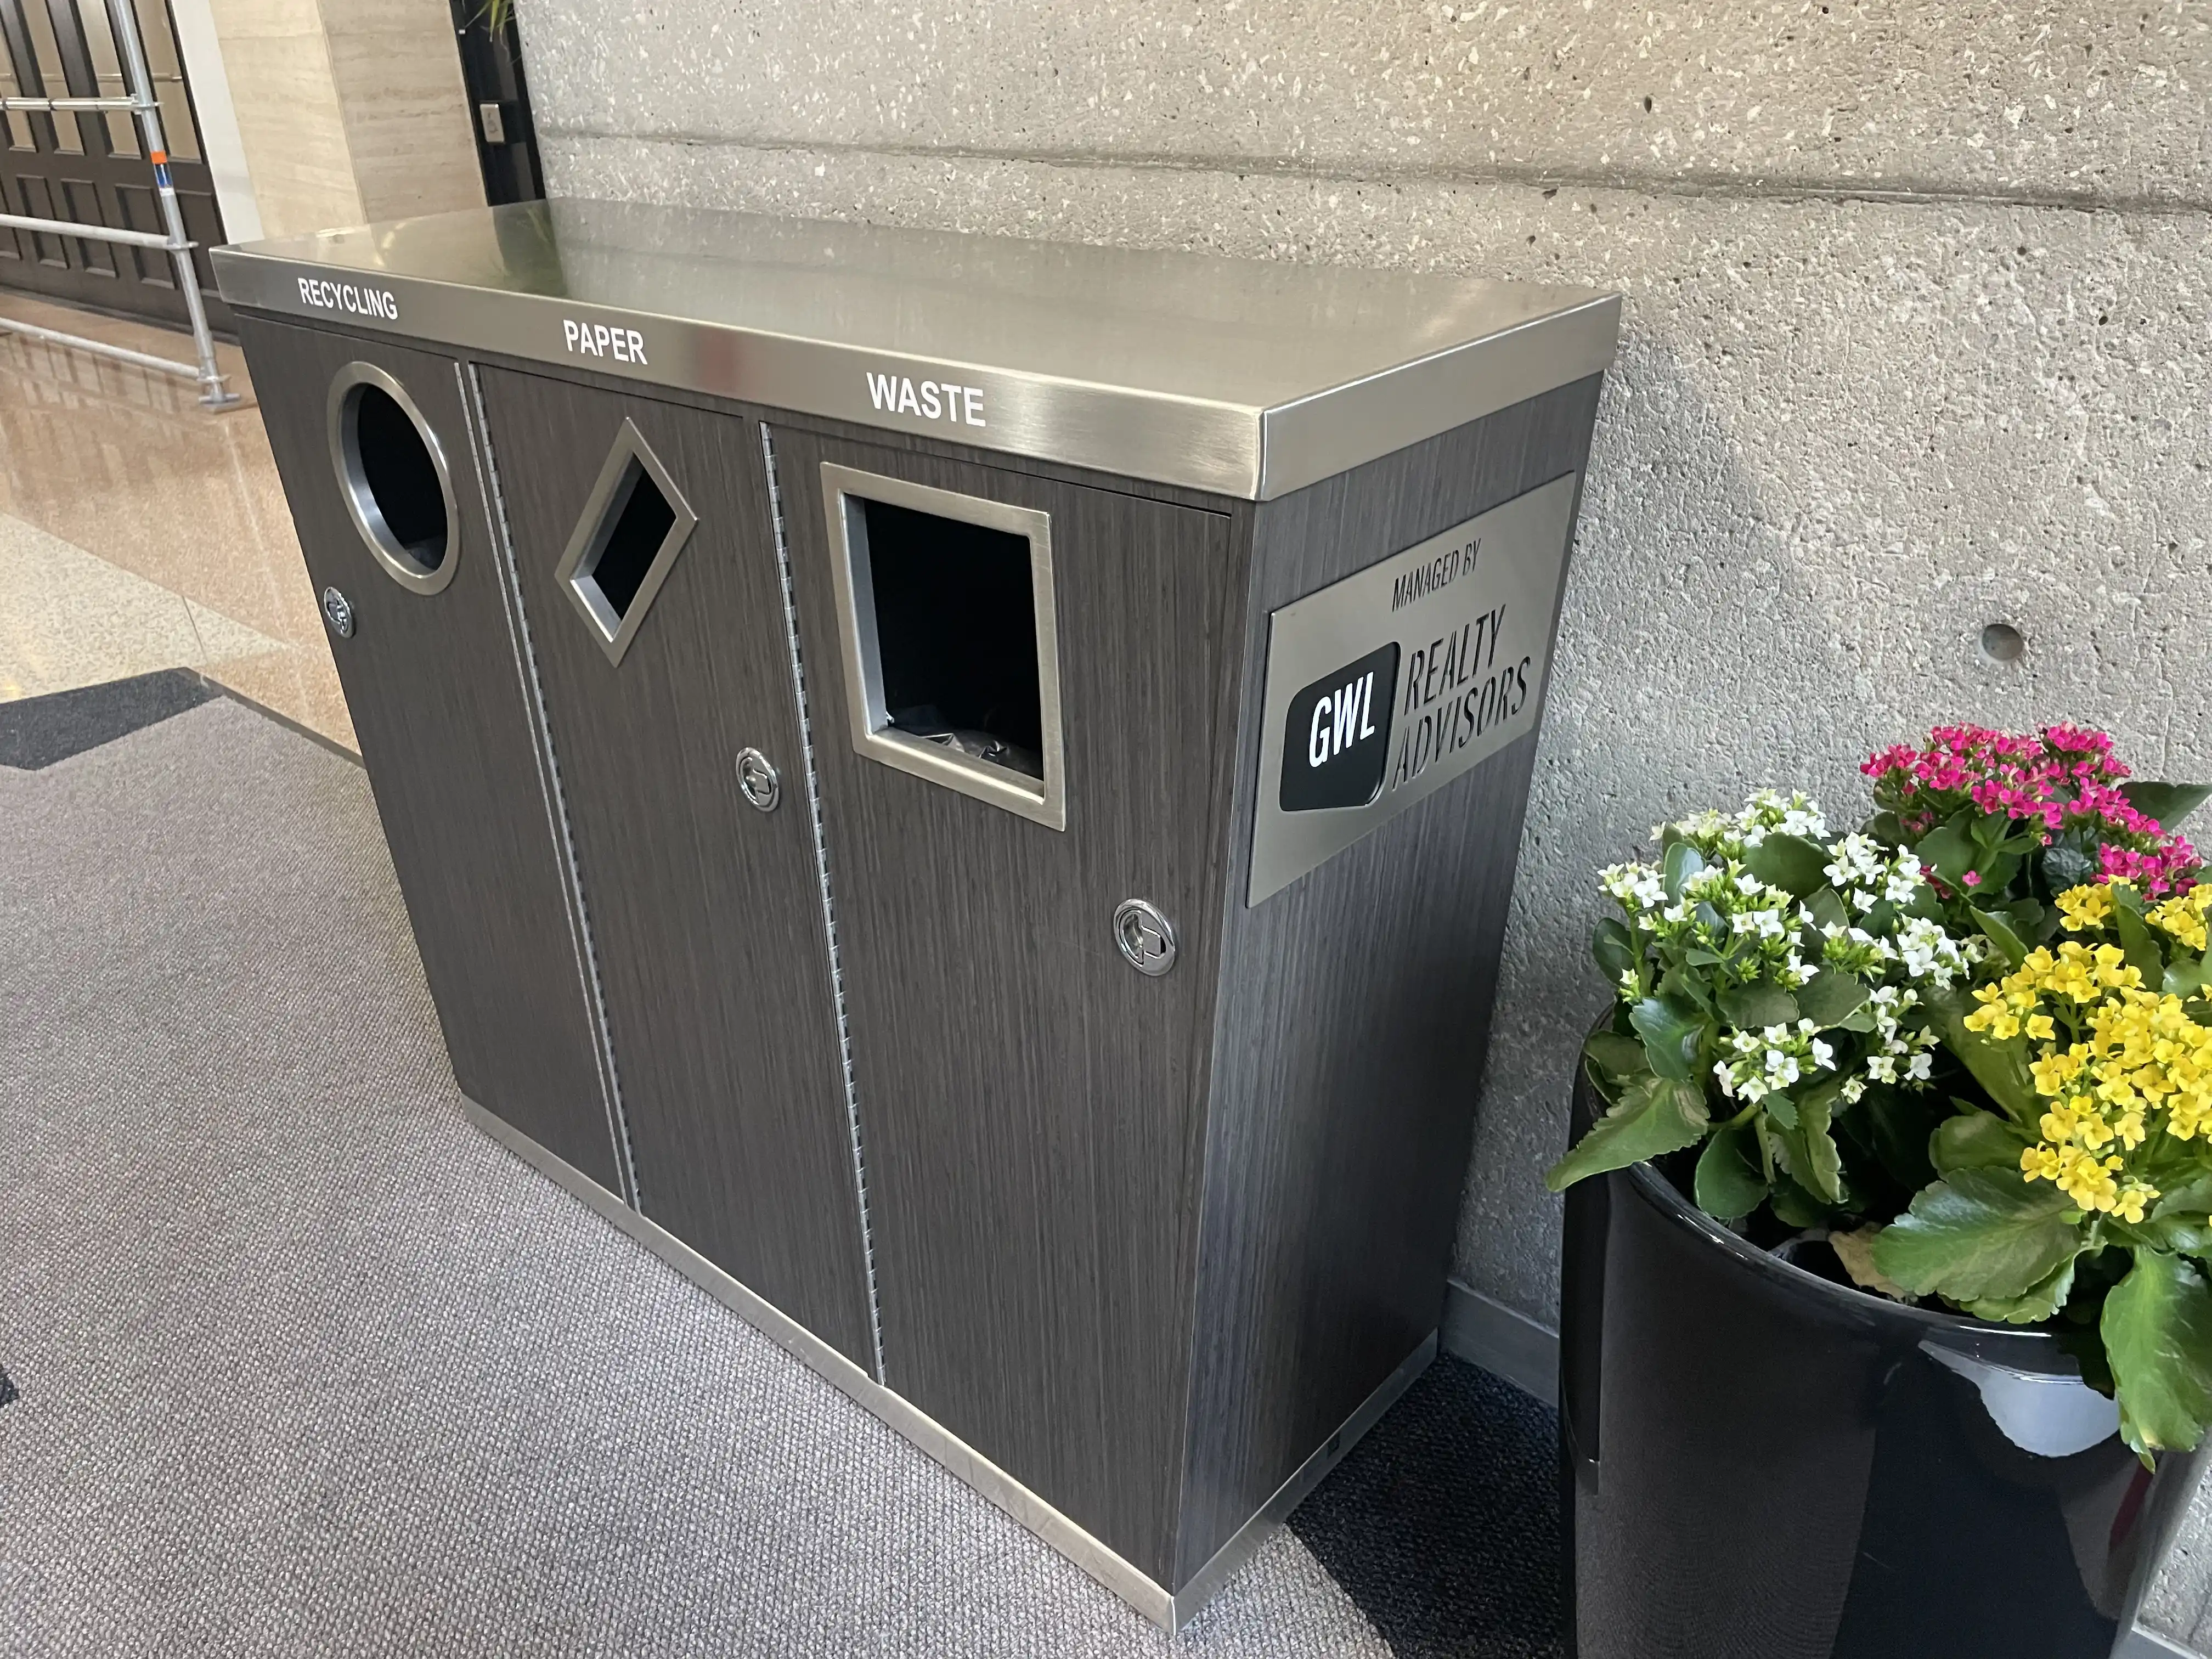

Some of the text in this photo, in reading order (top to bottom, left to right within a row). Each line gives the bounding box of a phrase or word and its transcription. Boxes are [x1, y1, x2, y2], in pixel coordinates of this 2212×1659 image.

[298, 277, 398, 320] RECYCLING
[563, 319, 648, 365] PAPER
[866, 371, 986, 427] WASTE
[1391, 538, 1482, 613] MANAGED BY
[1404, 604, 1506, 716] REALTY
[1308, 671, 1375, 768] GWL
[1392, 656, 1531, 792] ADVISORS
